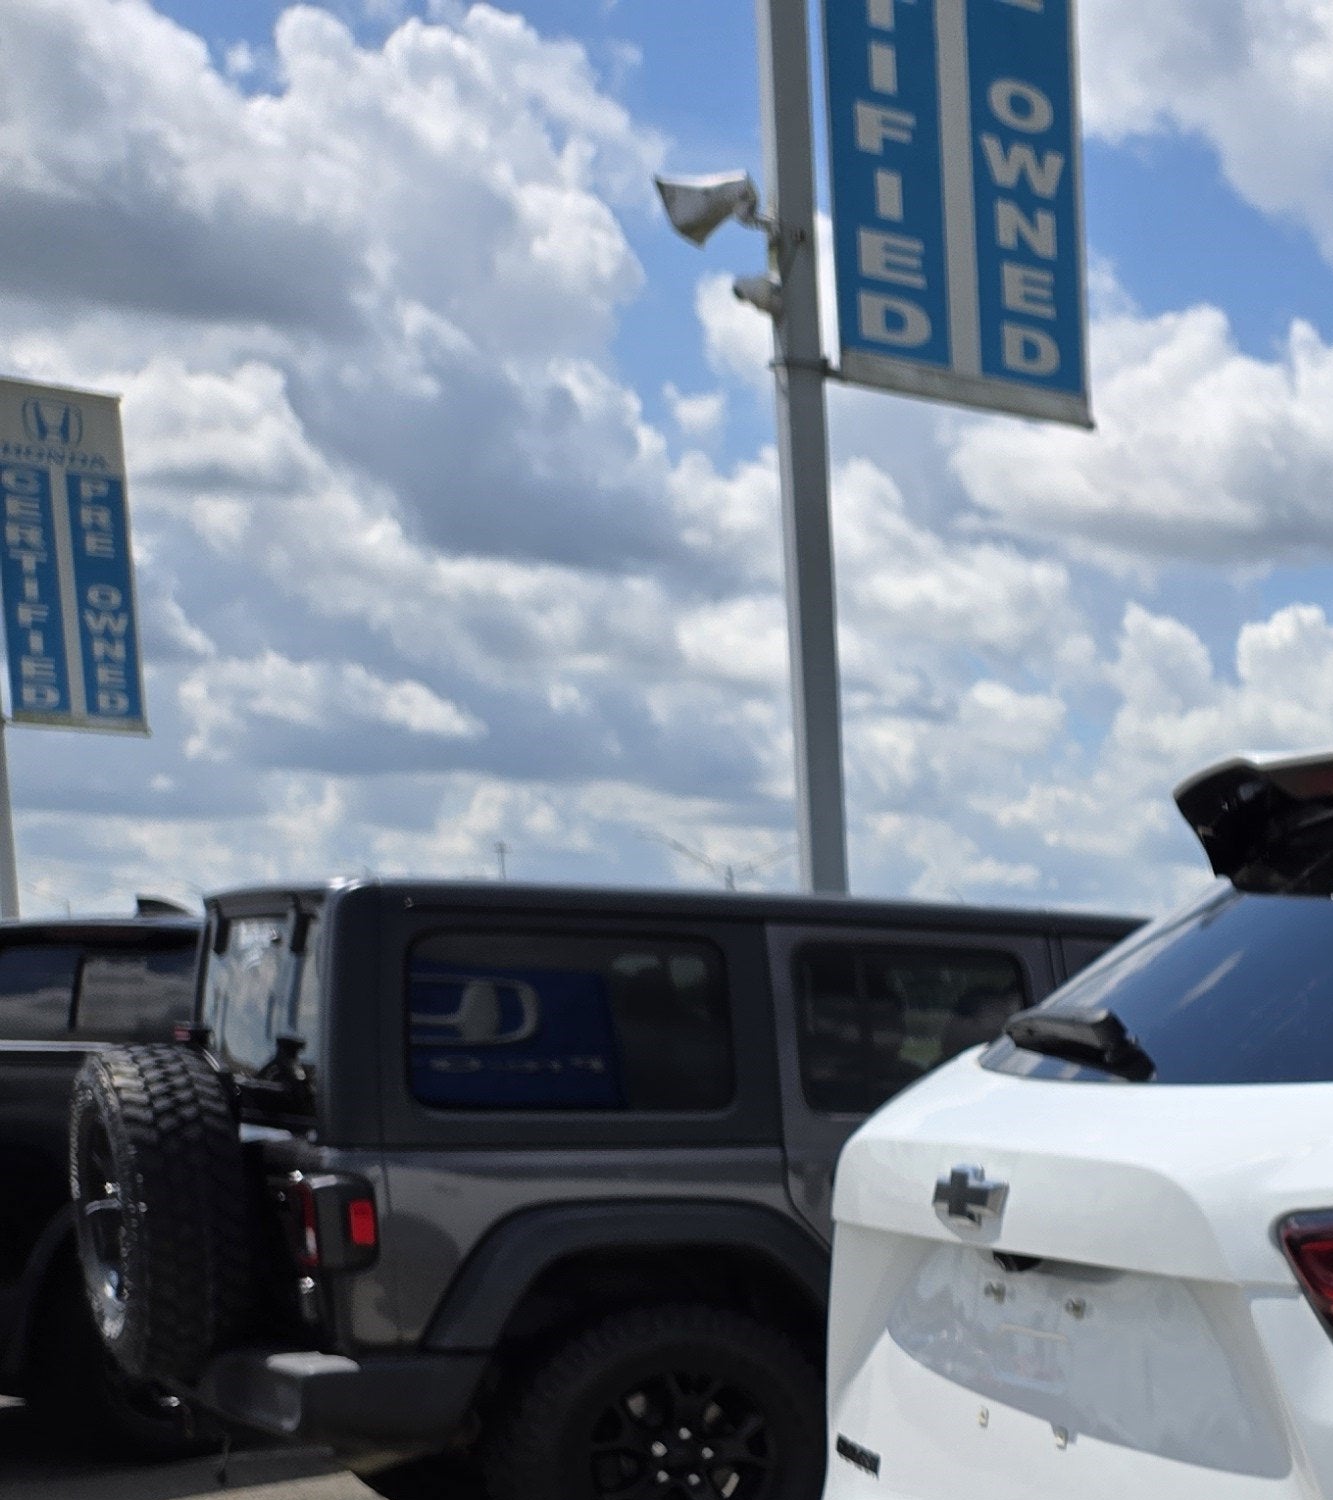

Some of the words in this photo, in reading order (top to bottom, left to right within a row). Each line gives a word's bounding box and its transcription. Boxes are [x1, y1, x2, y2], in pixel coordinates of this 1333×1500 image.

[979, 77, 1065, 378] OWNED
[1, 467, 61, 710] CERTIFIED
[80, 475, 115, 559] PRE
[83, 583, 130, 715] OWNED
